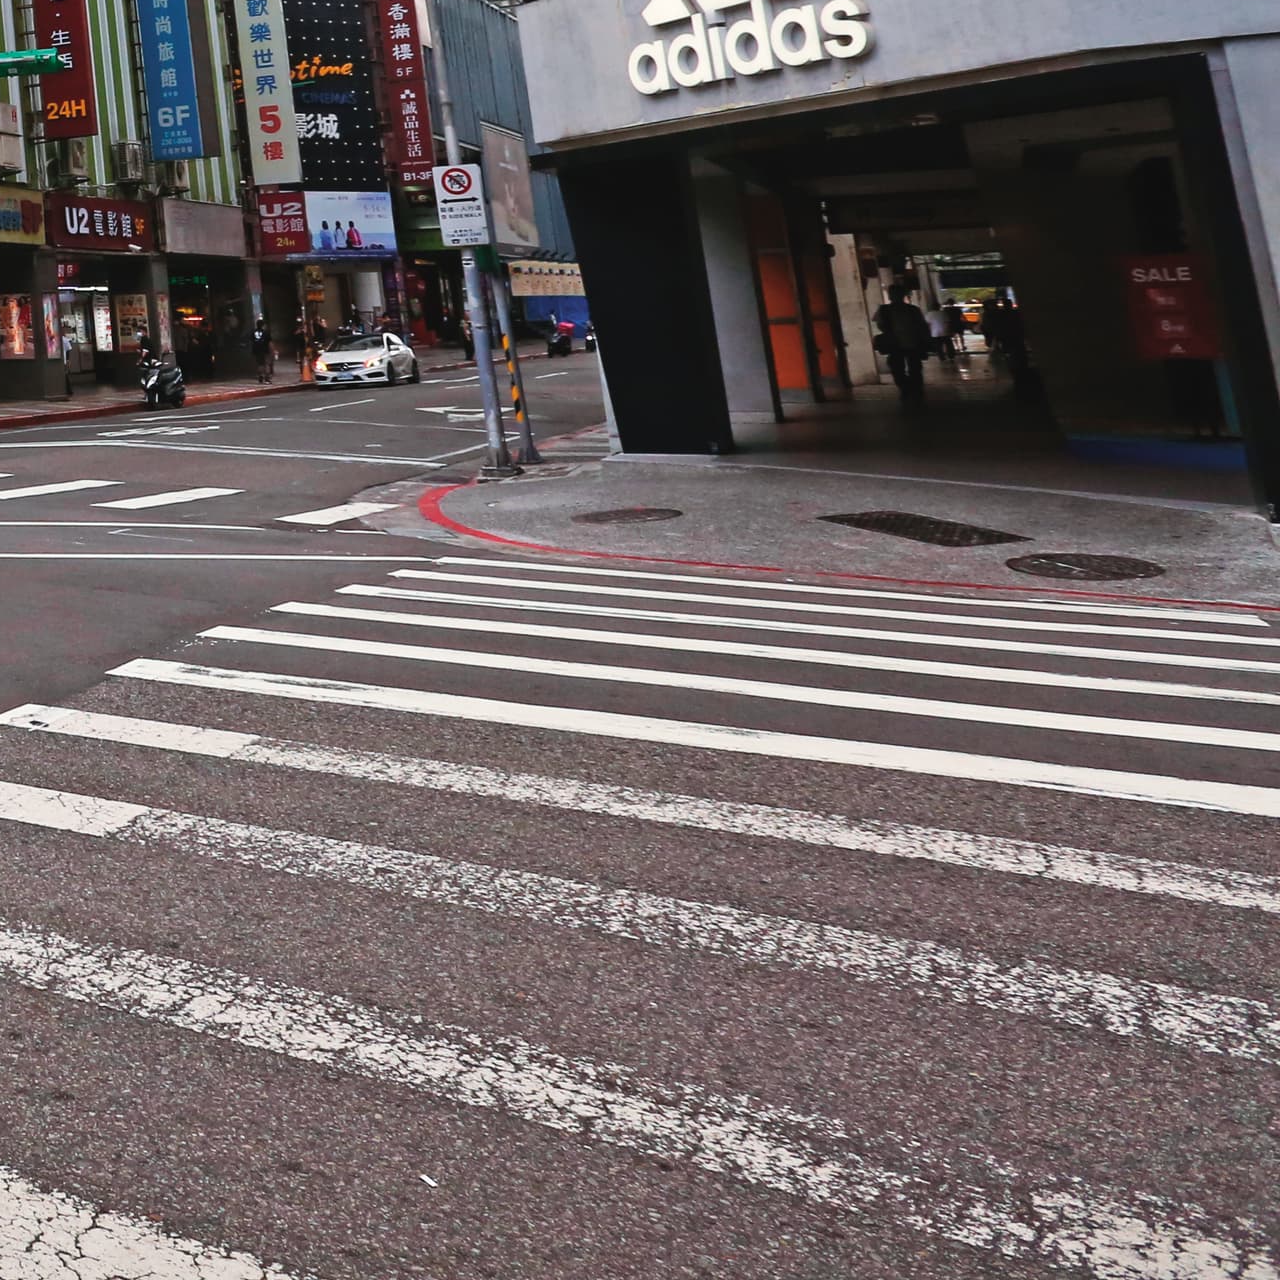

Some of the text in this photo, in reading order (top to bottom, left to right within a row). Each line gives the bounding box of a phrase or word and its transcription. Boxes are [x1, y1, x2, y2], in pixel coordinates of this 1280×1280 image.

[388, 4, 413, 61] 香滿樓
[396, 67, 413, 77] 5F
[46, 101, 88, 121] 24H
[157, 105, 190, 128] 6F
[295, 113, 340, 139] 影城
[402, 102, 423, 157] 誠品生活
[403, 171, 433, 182] B1-3F
[260, 202, 303, 217] U2
[65, 206, 90, 235] U2
[260, 218, 304, 234] 電影館
[1131, 267, 1192, 282] SALE
